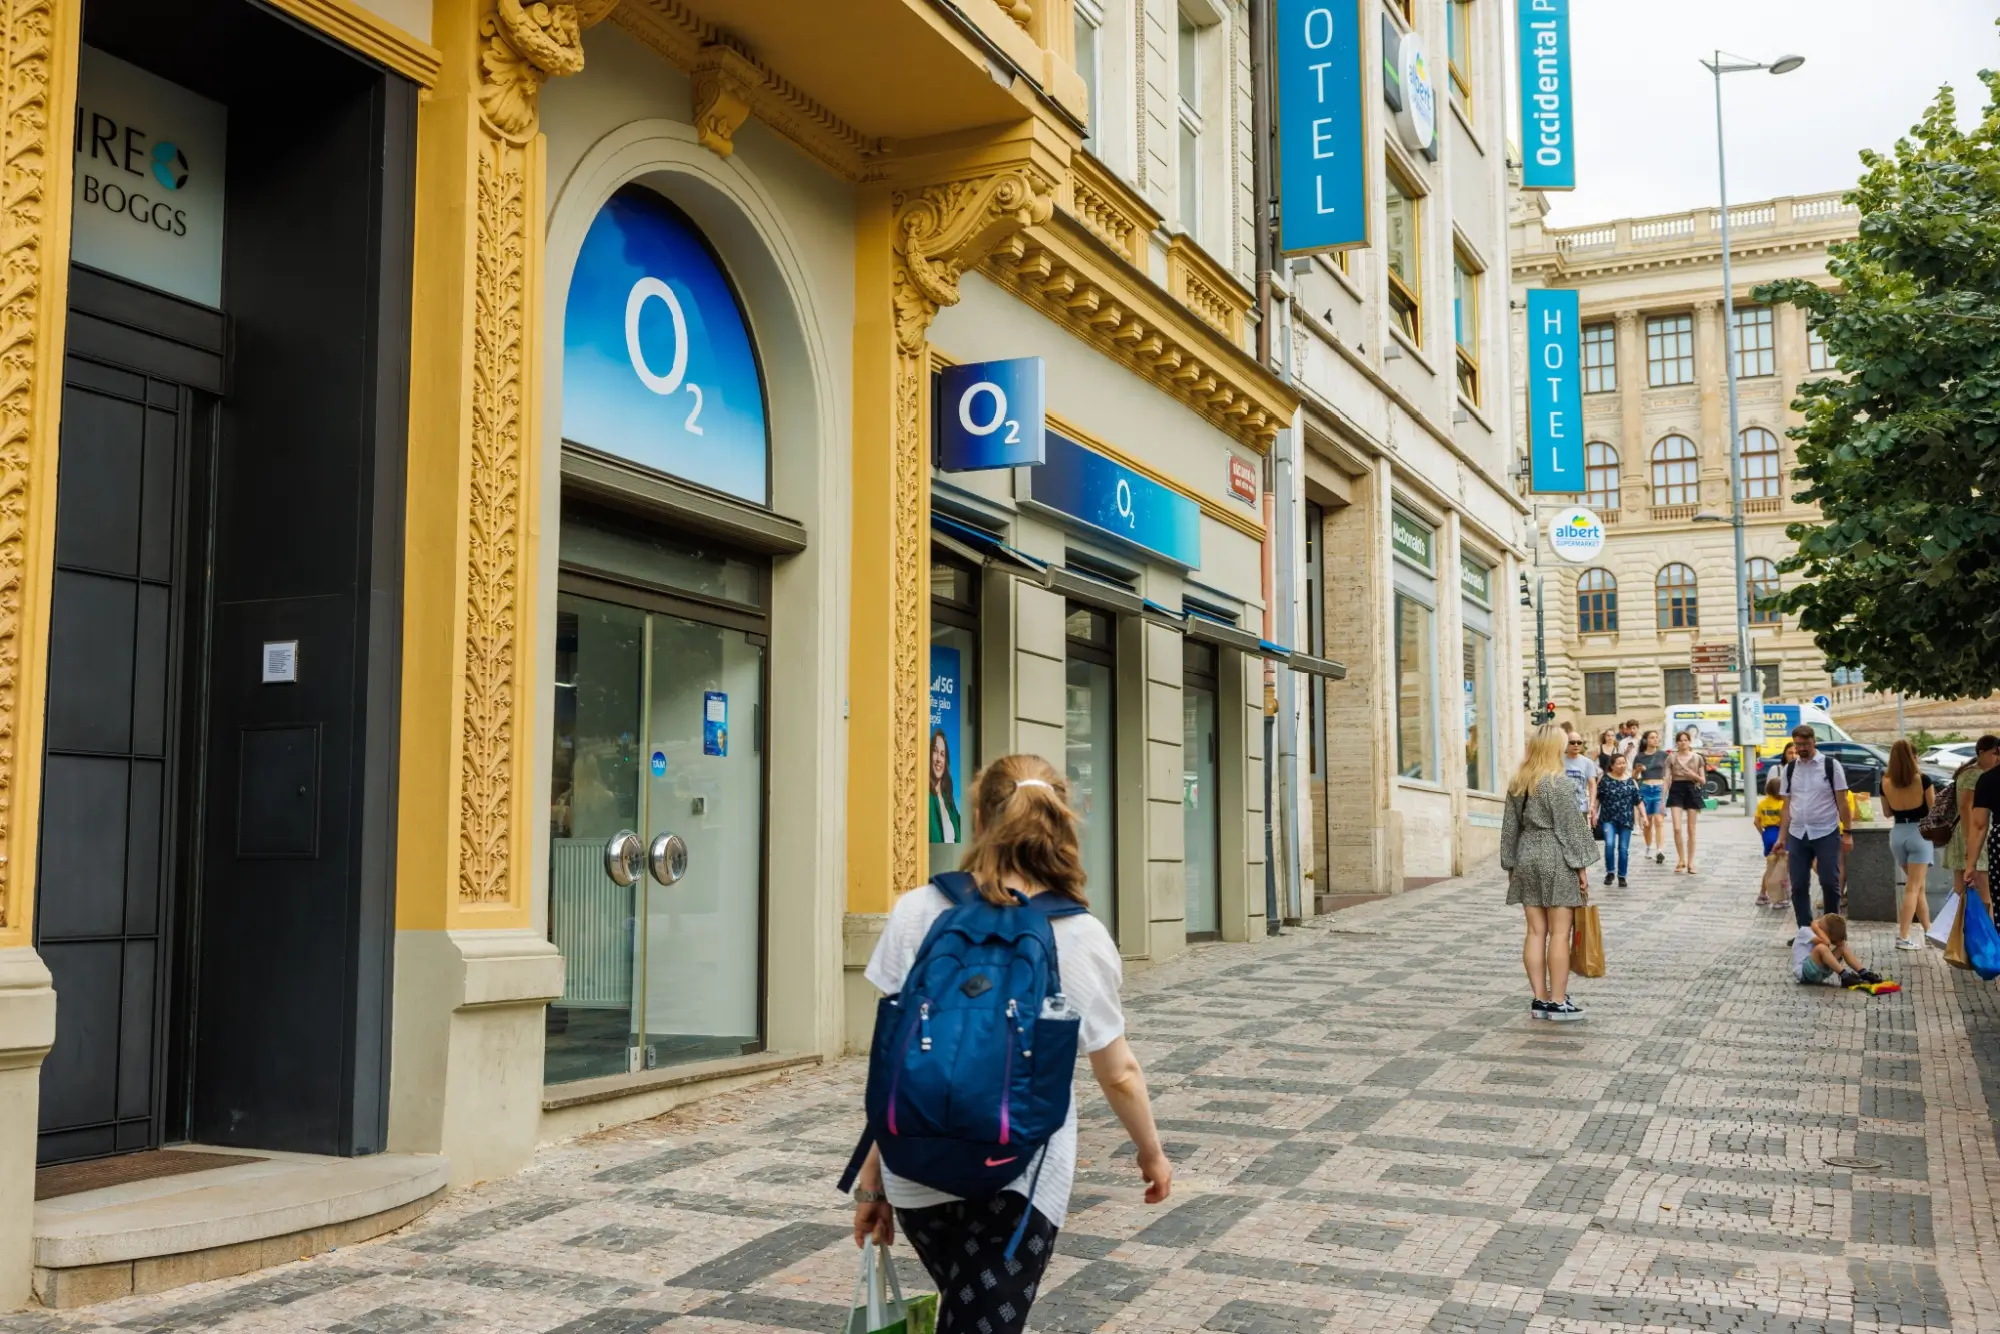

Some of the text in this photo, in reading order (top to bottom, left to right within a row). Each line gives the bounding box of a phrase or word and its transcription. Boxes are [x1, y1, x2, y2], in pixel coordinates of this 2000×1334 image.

[1304, 8, 1335, 215] OTEL
[1530, 20, 1561, 167] Occidental
[84, 174, 187, 237] BOGGS
[624, 276, 704, 436] O2
[958, 381, 1021, 445] O2
[1543, 308, 1565, 473] HOTEL
[1116, 479, 1135, 529] O2
[1556, 525, 1600, 539] albert
[1392, 522, 1426, 557] McDonald's
[941, 677, 953, 694] 5G
